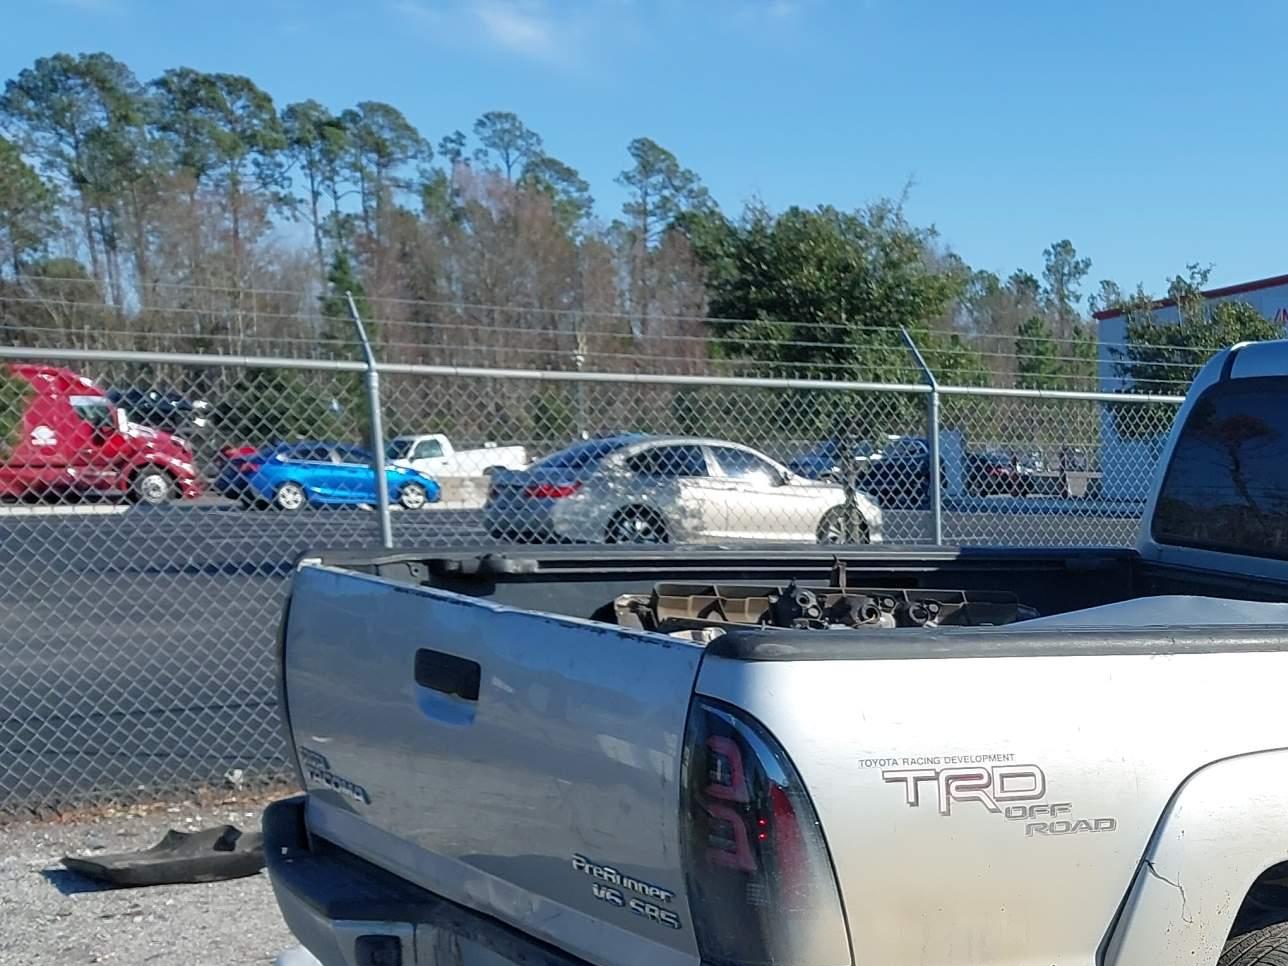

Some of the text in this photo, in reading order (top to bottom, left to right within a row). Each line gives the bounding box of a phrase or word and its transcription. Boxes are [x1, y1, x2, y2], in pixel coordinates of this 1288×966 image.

[858, 753, 1016, 768] TOYOTA RACING DEVELOPMENT
[882, 764, 1047, 816] TRD
[1004, 802, 1073, 819] OFF
[1025, 818, 1117, 837] ROAD
[571, 853, 676, 903] PreRunner
[592, 882, 625, 907] V6
